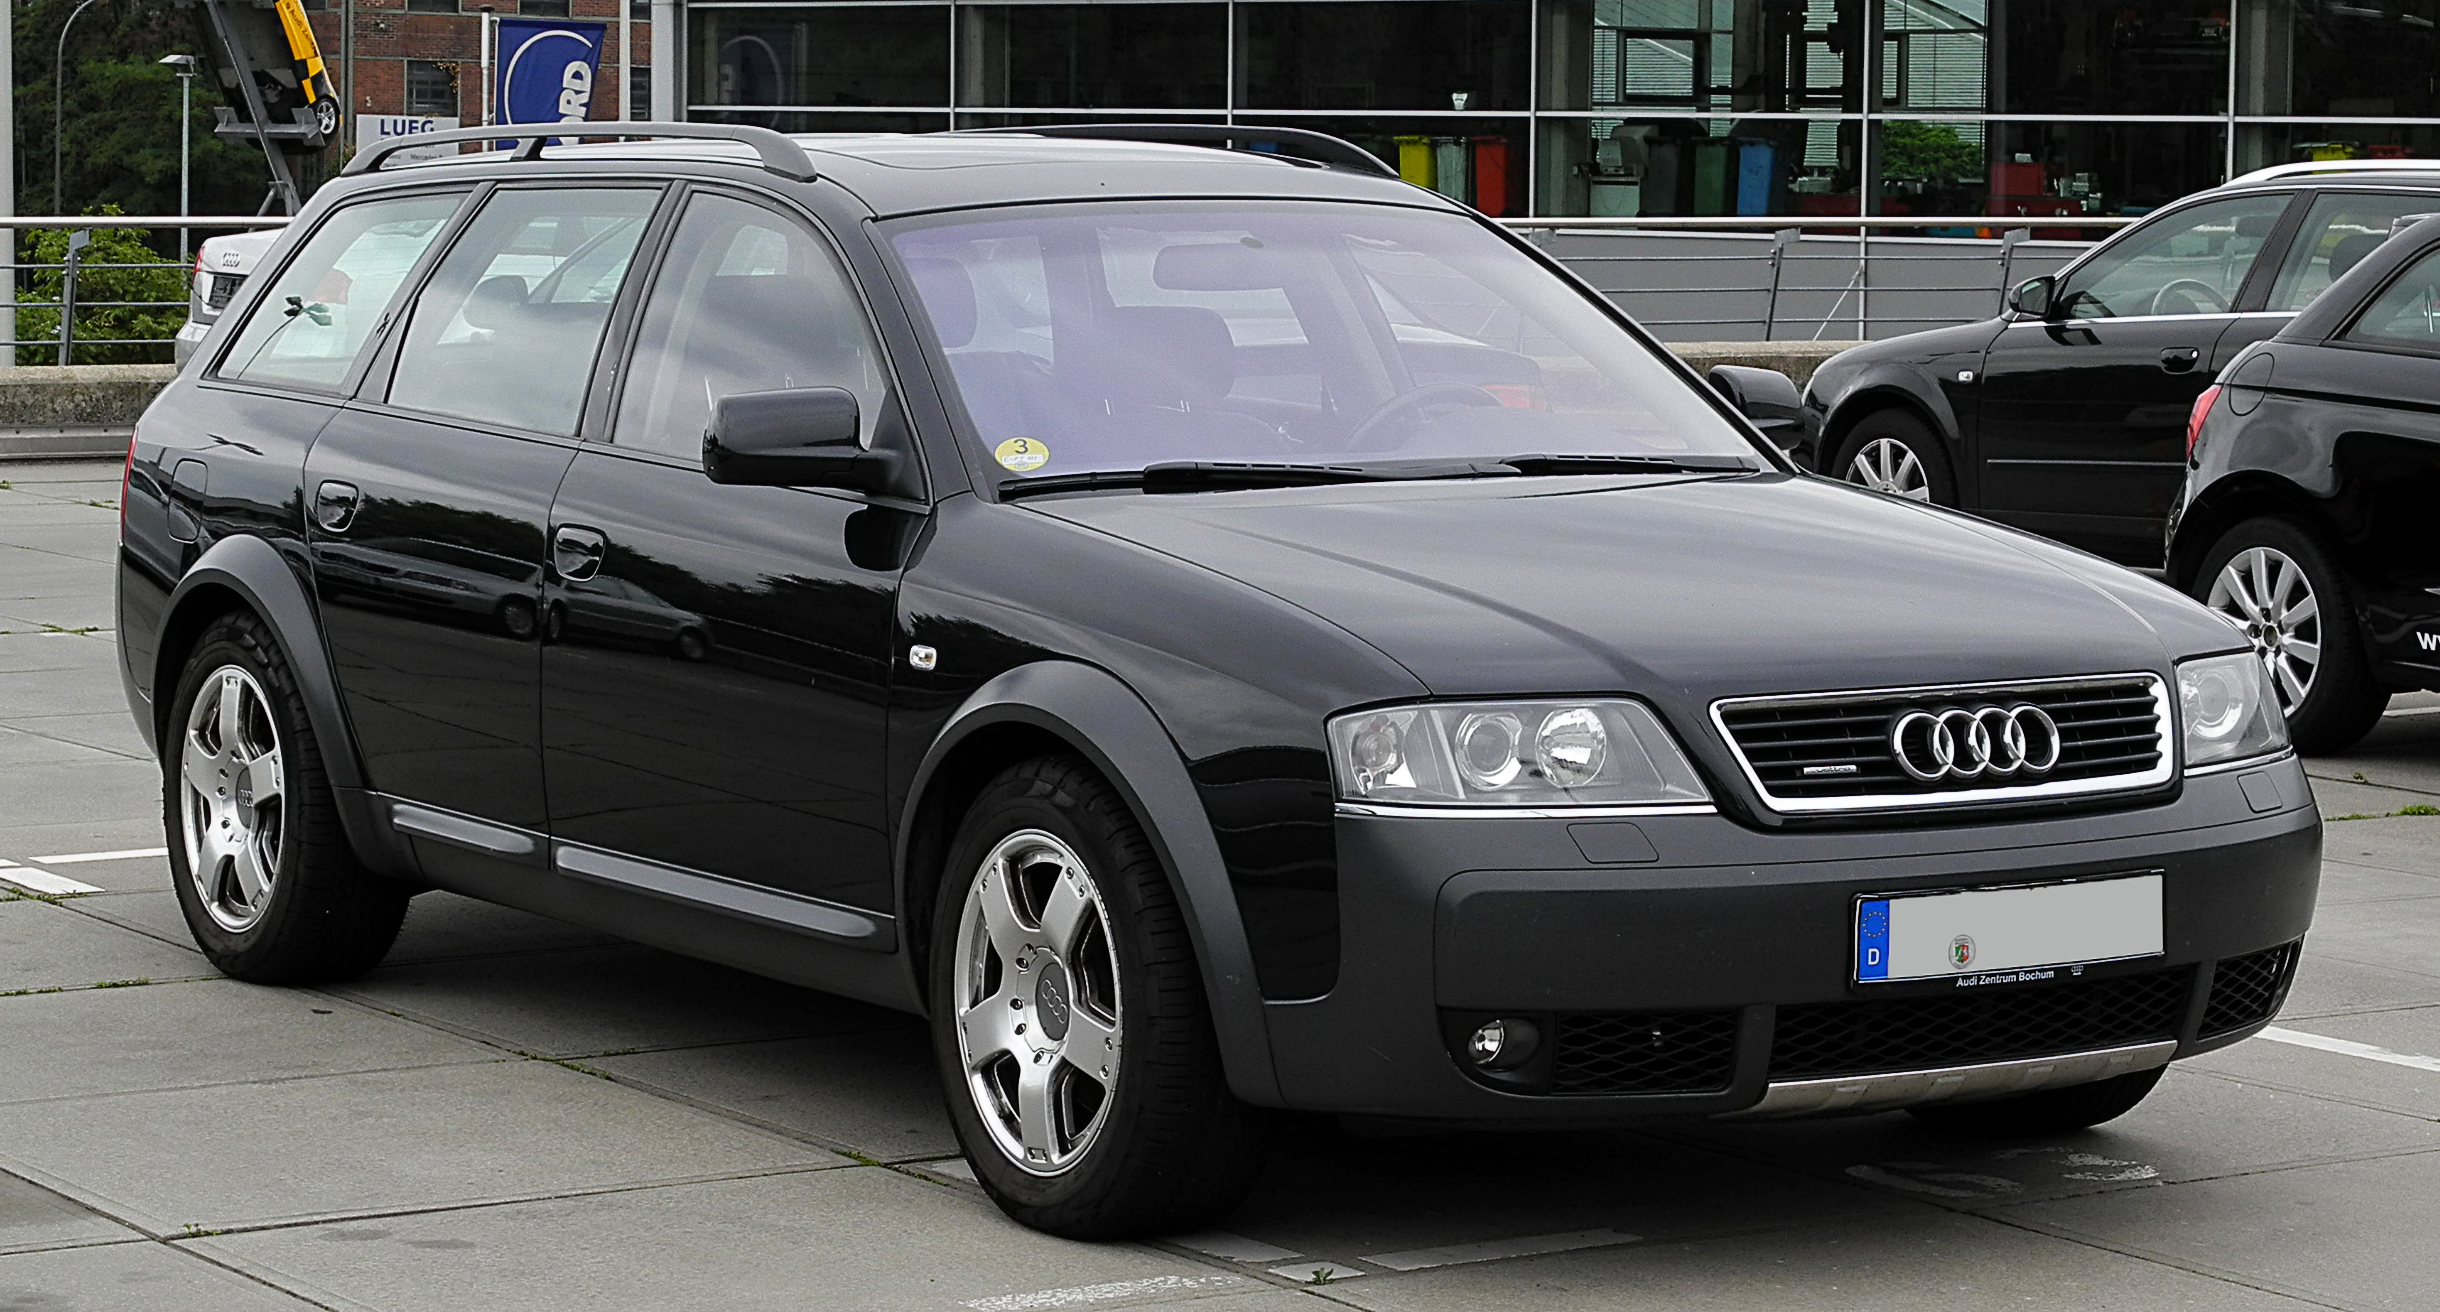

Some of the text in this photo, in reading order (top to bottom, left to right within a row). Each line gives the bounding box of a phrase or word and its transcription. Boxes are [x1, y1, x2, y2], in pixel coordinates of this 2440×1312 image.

[380, 118, 434, 136] LUEG
[1013, 438, 1029, 454] 3
[2416, 631, 2440, 651] W
[1867, 947, 1881, 966] D
[1956, 970, 2055, 988] Audi Zentrum Bochum
